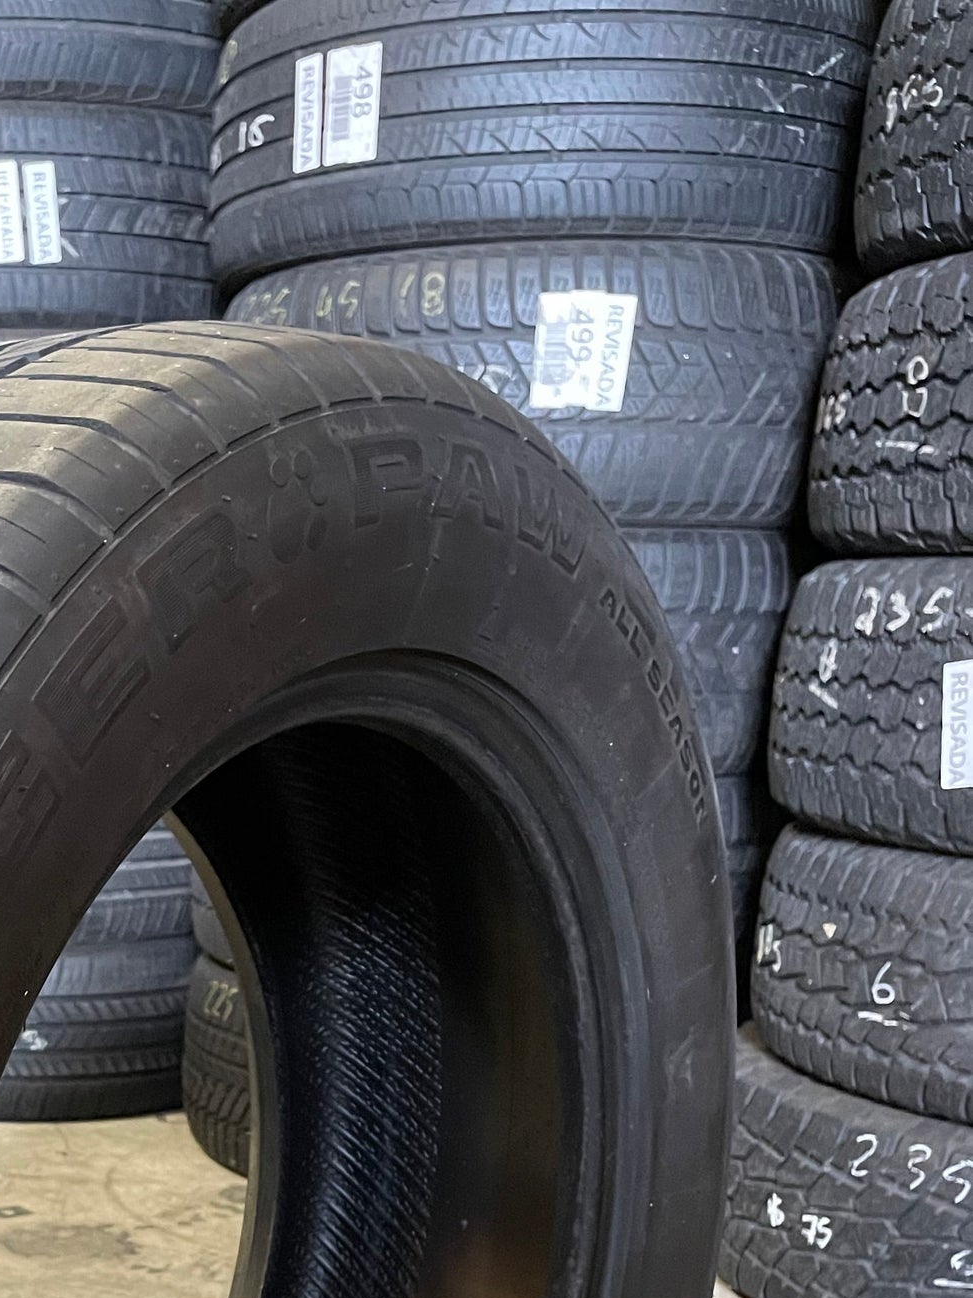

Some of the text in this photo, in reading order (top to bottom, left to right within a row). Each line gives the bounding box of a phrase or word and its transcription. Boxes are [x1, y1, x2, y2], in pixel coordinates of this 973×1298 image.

[351, 65, 374, 118] 498
[595, 304, 626, 408] REVISADA
[345, 435, 589, 578] PAW
[598, 588, 642, 660] ALL
[947, 672, 969, 786] REVISADA
[871, 960, 896, 1005] 6
